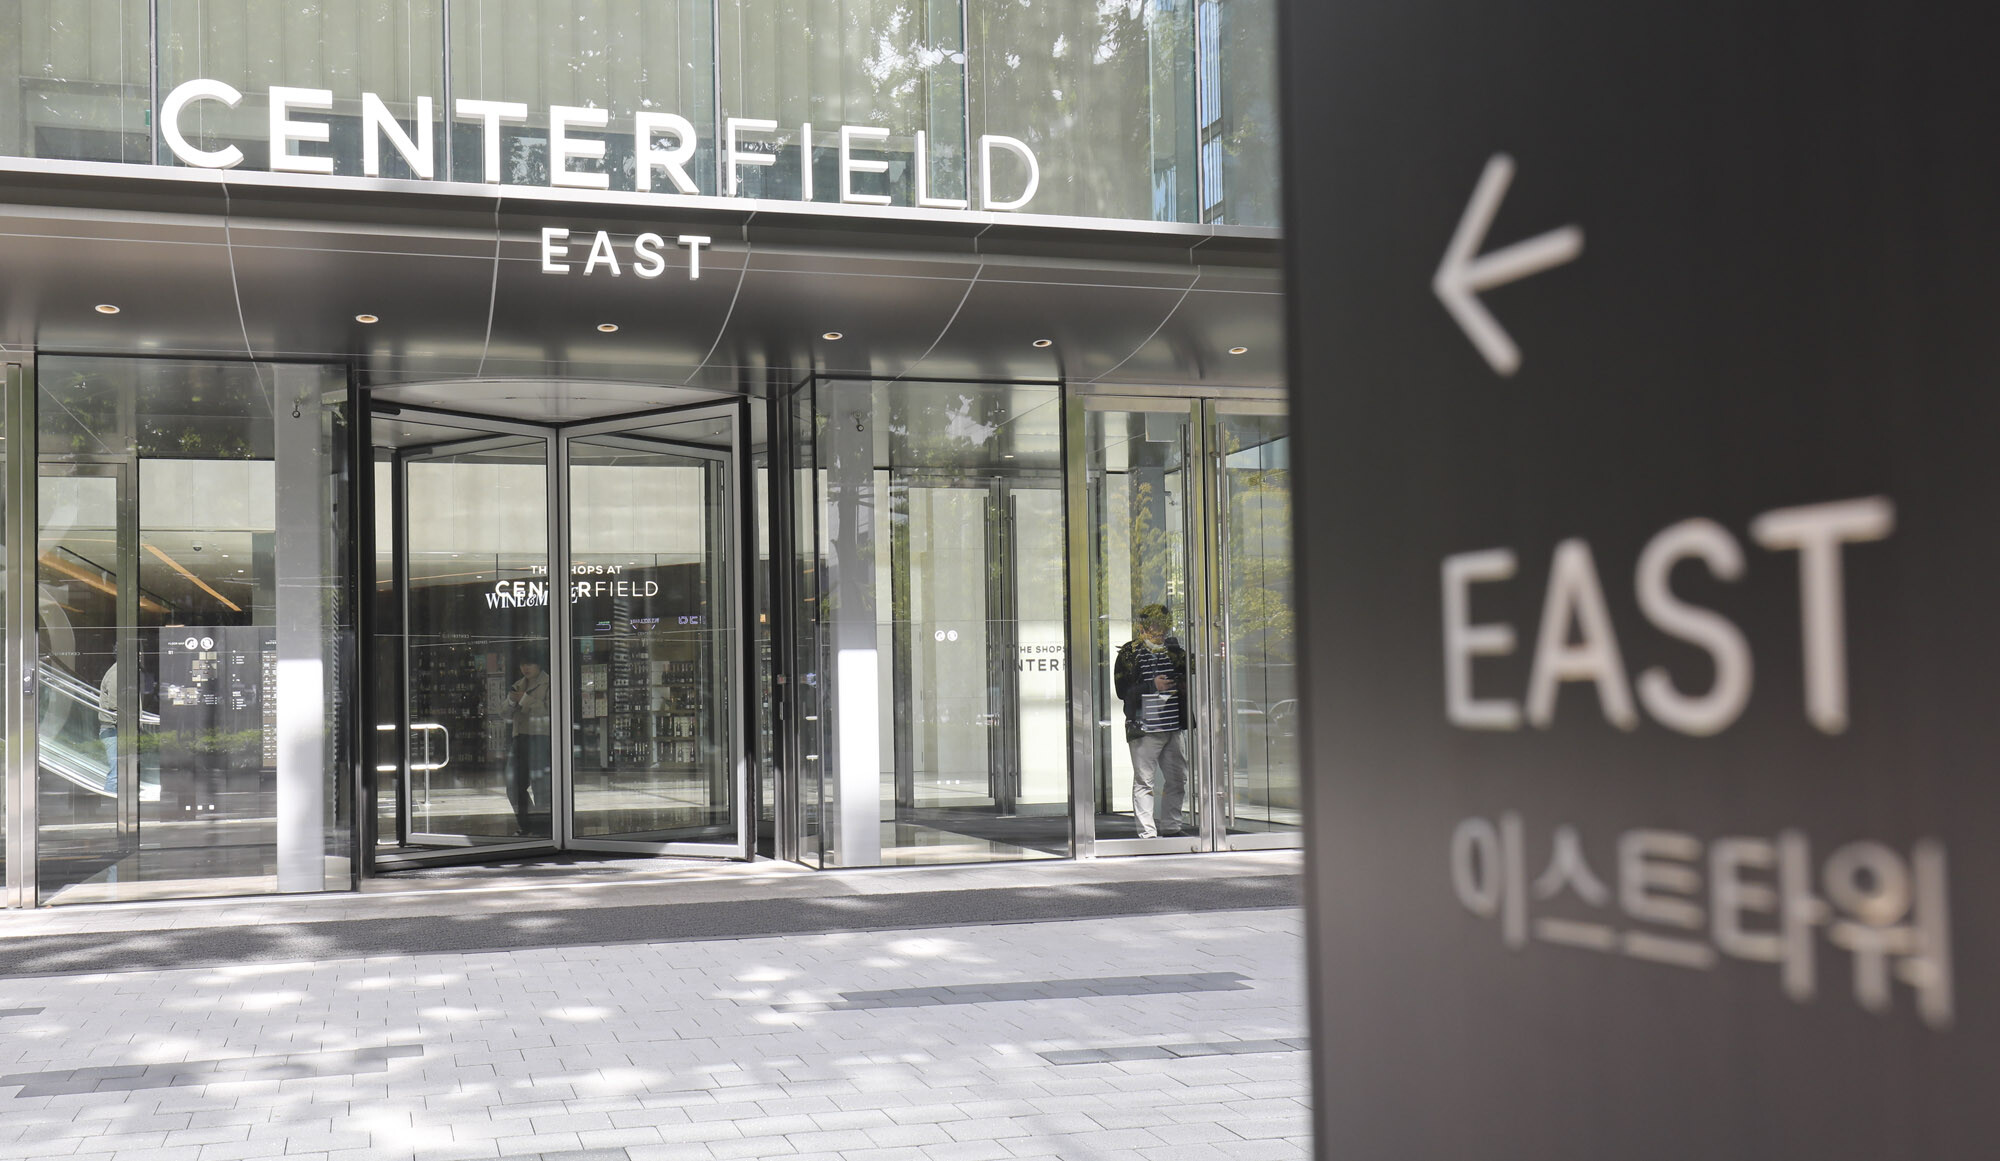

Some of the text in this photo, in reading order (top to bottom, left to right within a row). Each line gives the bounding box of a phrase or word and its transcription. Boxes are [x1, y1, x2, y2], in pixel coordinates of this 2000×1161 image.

[160, 78, 1041, 212] CENTERFIELD
[541, 226, 712, 281] EAST
[530, 565, 623, 575] TH HOPS AT
[1440, 494, 1896, 737] EAST
[1450, 810, 1954, 1032] 이스트타워
